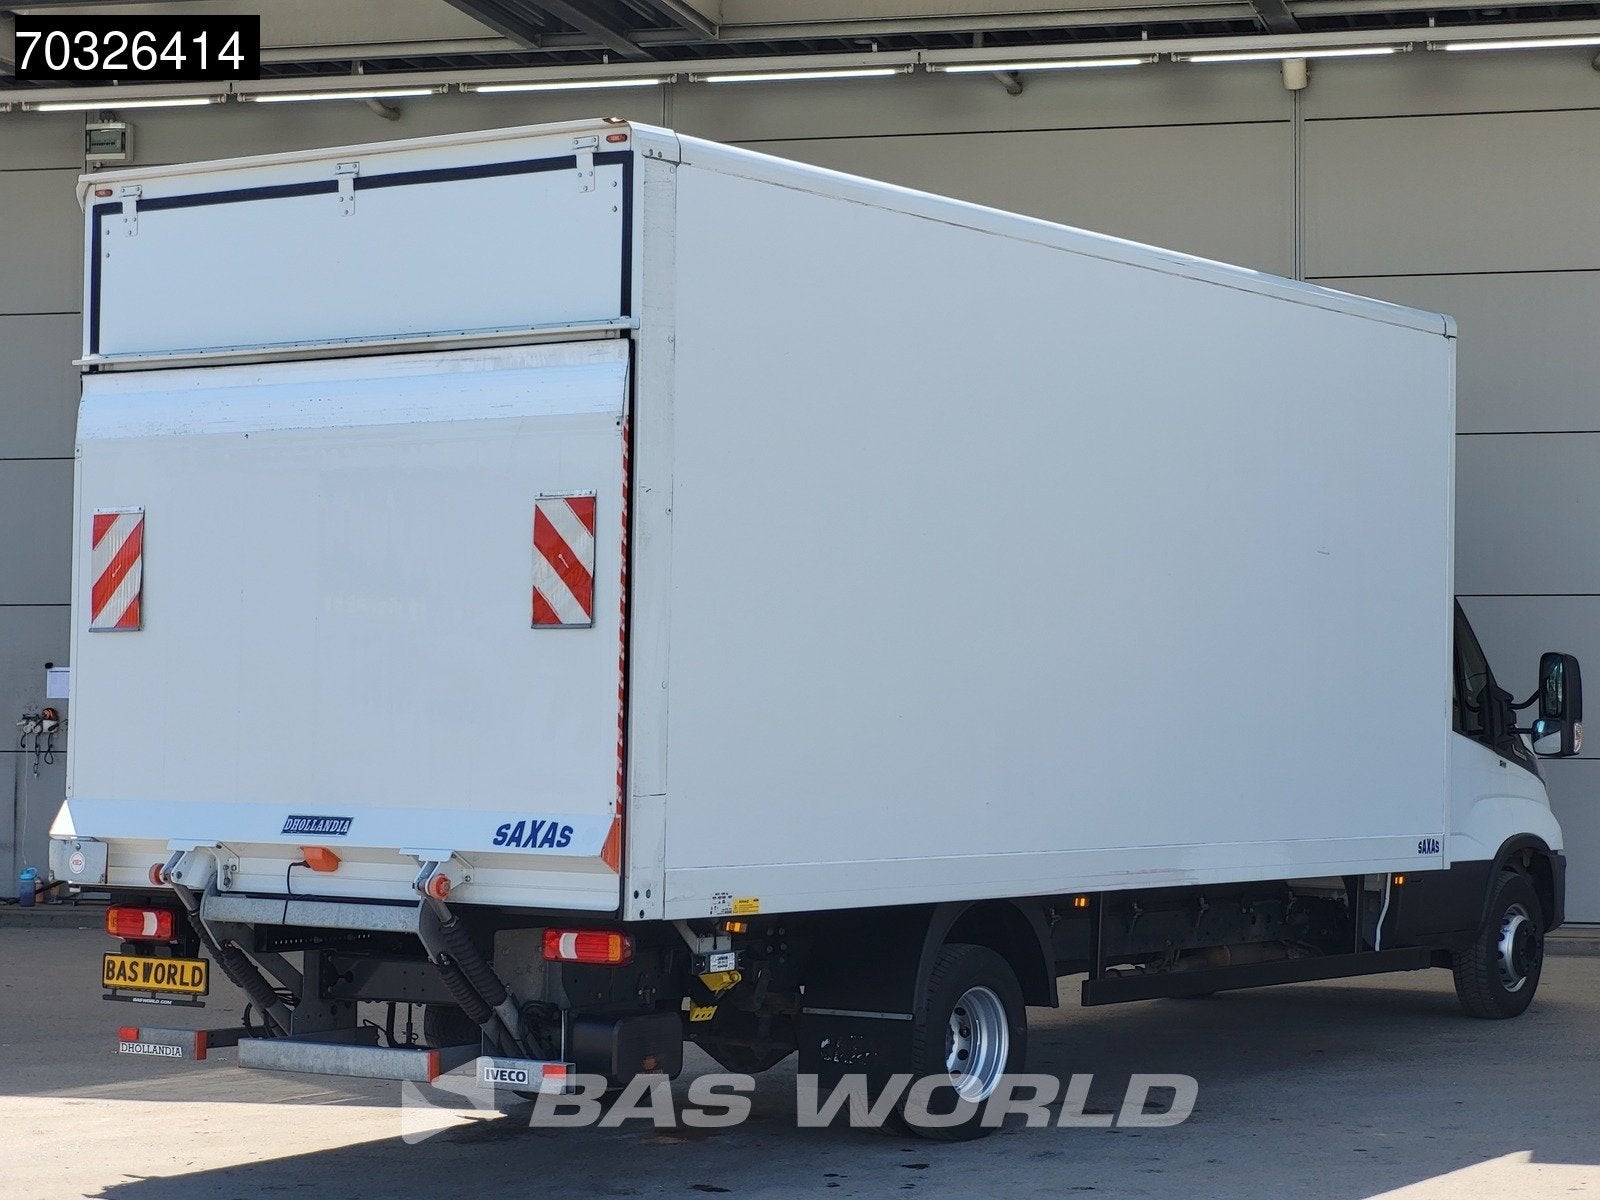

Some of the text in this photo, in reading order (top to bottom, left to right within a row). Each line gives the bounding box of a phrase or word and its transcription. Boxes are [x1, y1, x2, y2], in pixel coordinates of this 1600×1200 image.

[283, 818, 350, 833] DHOLLANDIA
[1417, 838, 1440, 854] SAXAS
[121, 1042, 182, 1056] DHOLLANDIA
[485, 1067, 527, 1083] IVECO
